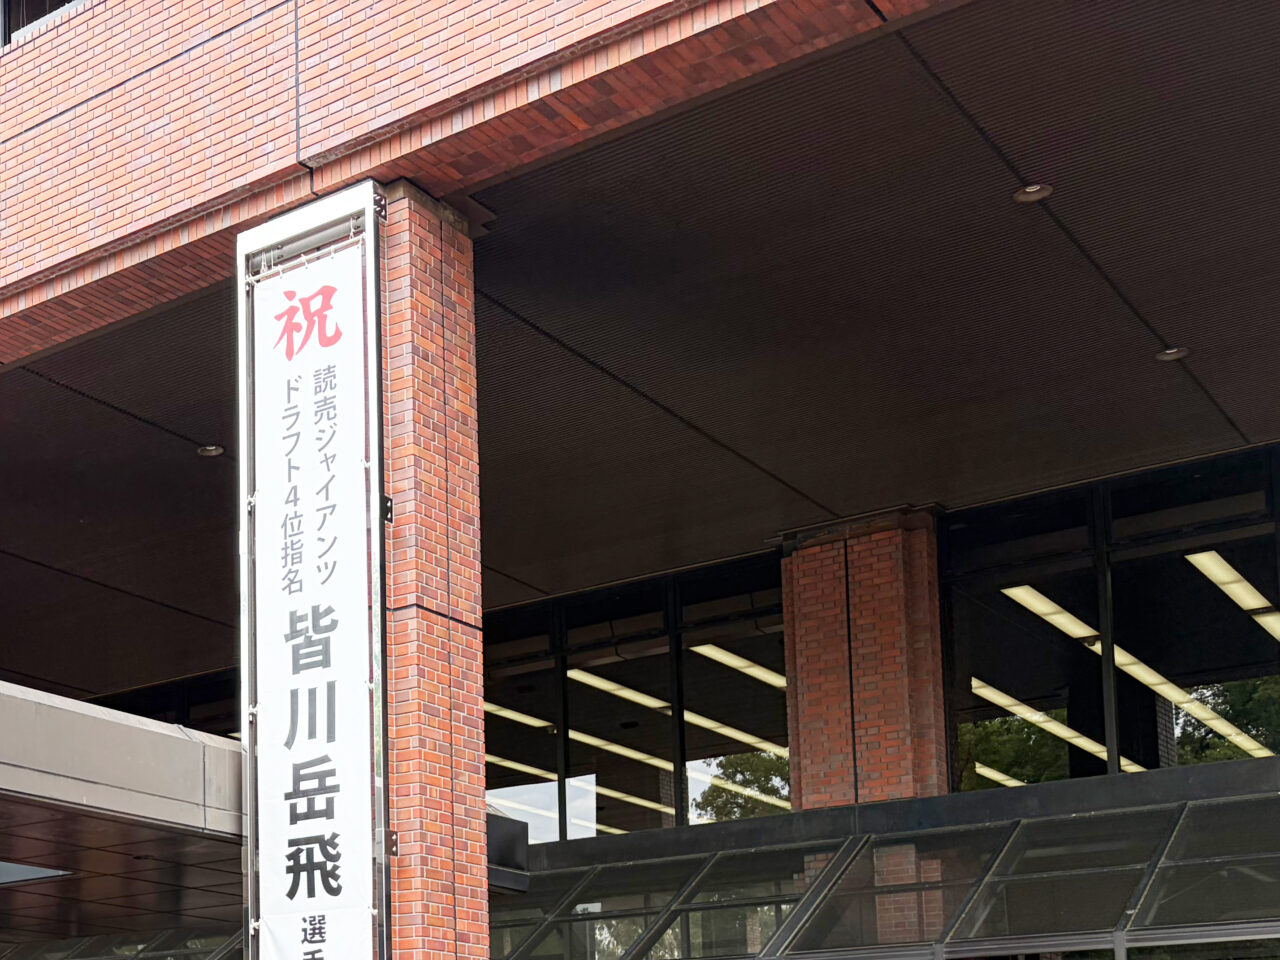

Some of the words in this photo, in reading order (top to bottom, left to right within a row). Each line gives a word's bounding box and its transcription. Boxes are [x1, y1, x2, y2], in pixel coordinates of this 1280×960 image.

[272, 284, 343, 362] 祝
[280, 374, 305, 597] ドラフト4位指名
[312, 363, 340, 587] 読売ジャイアンツ
[282, 603, 344, 902] 皆川岳飛
